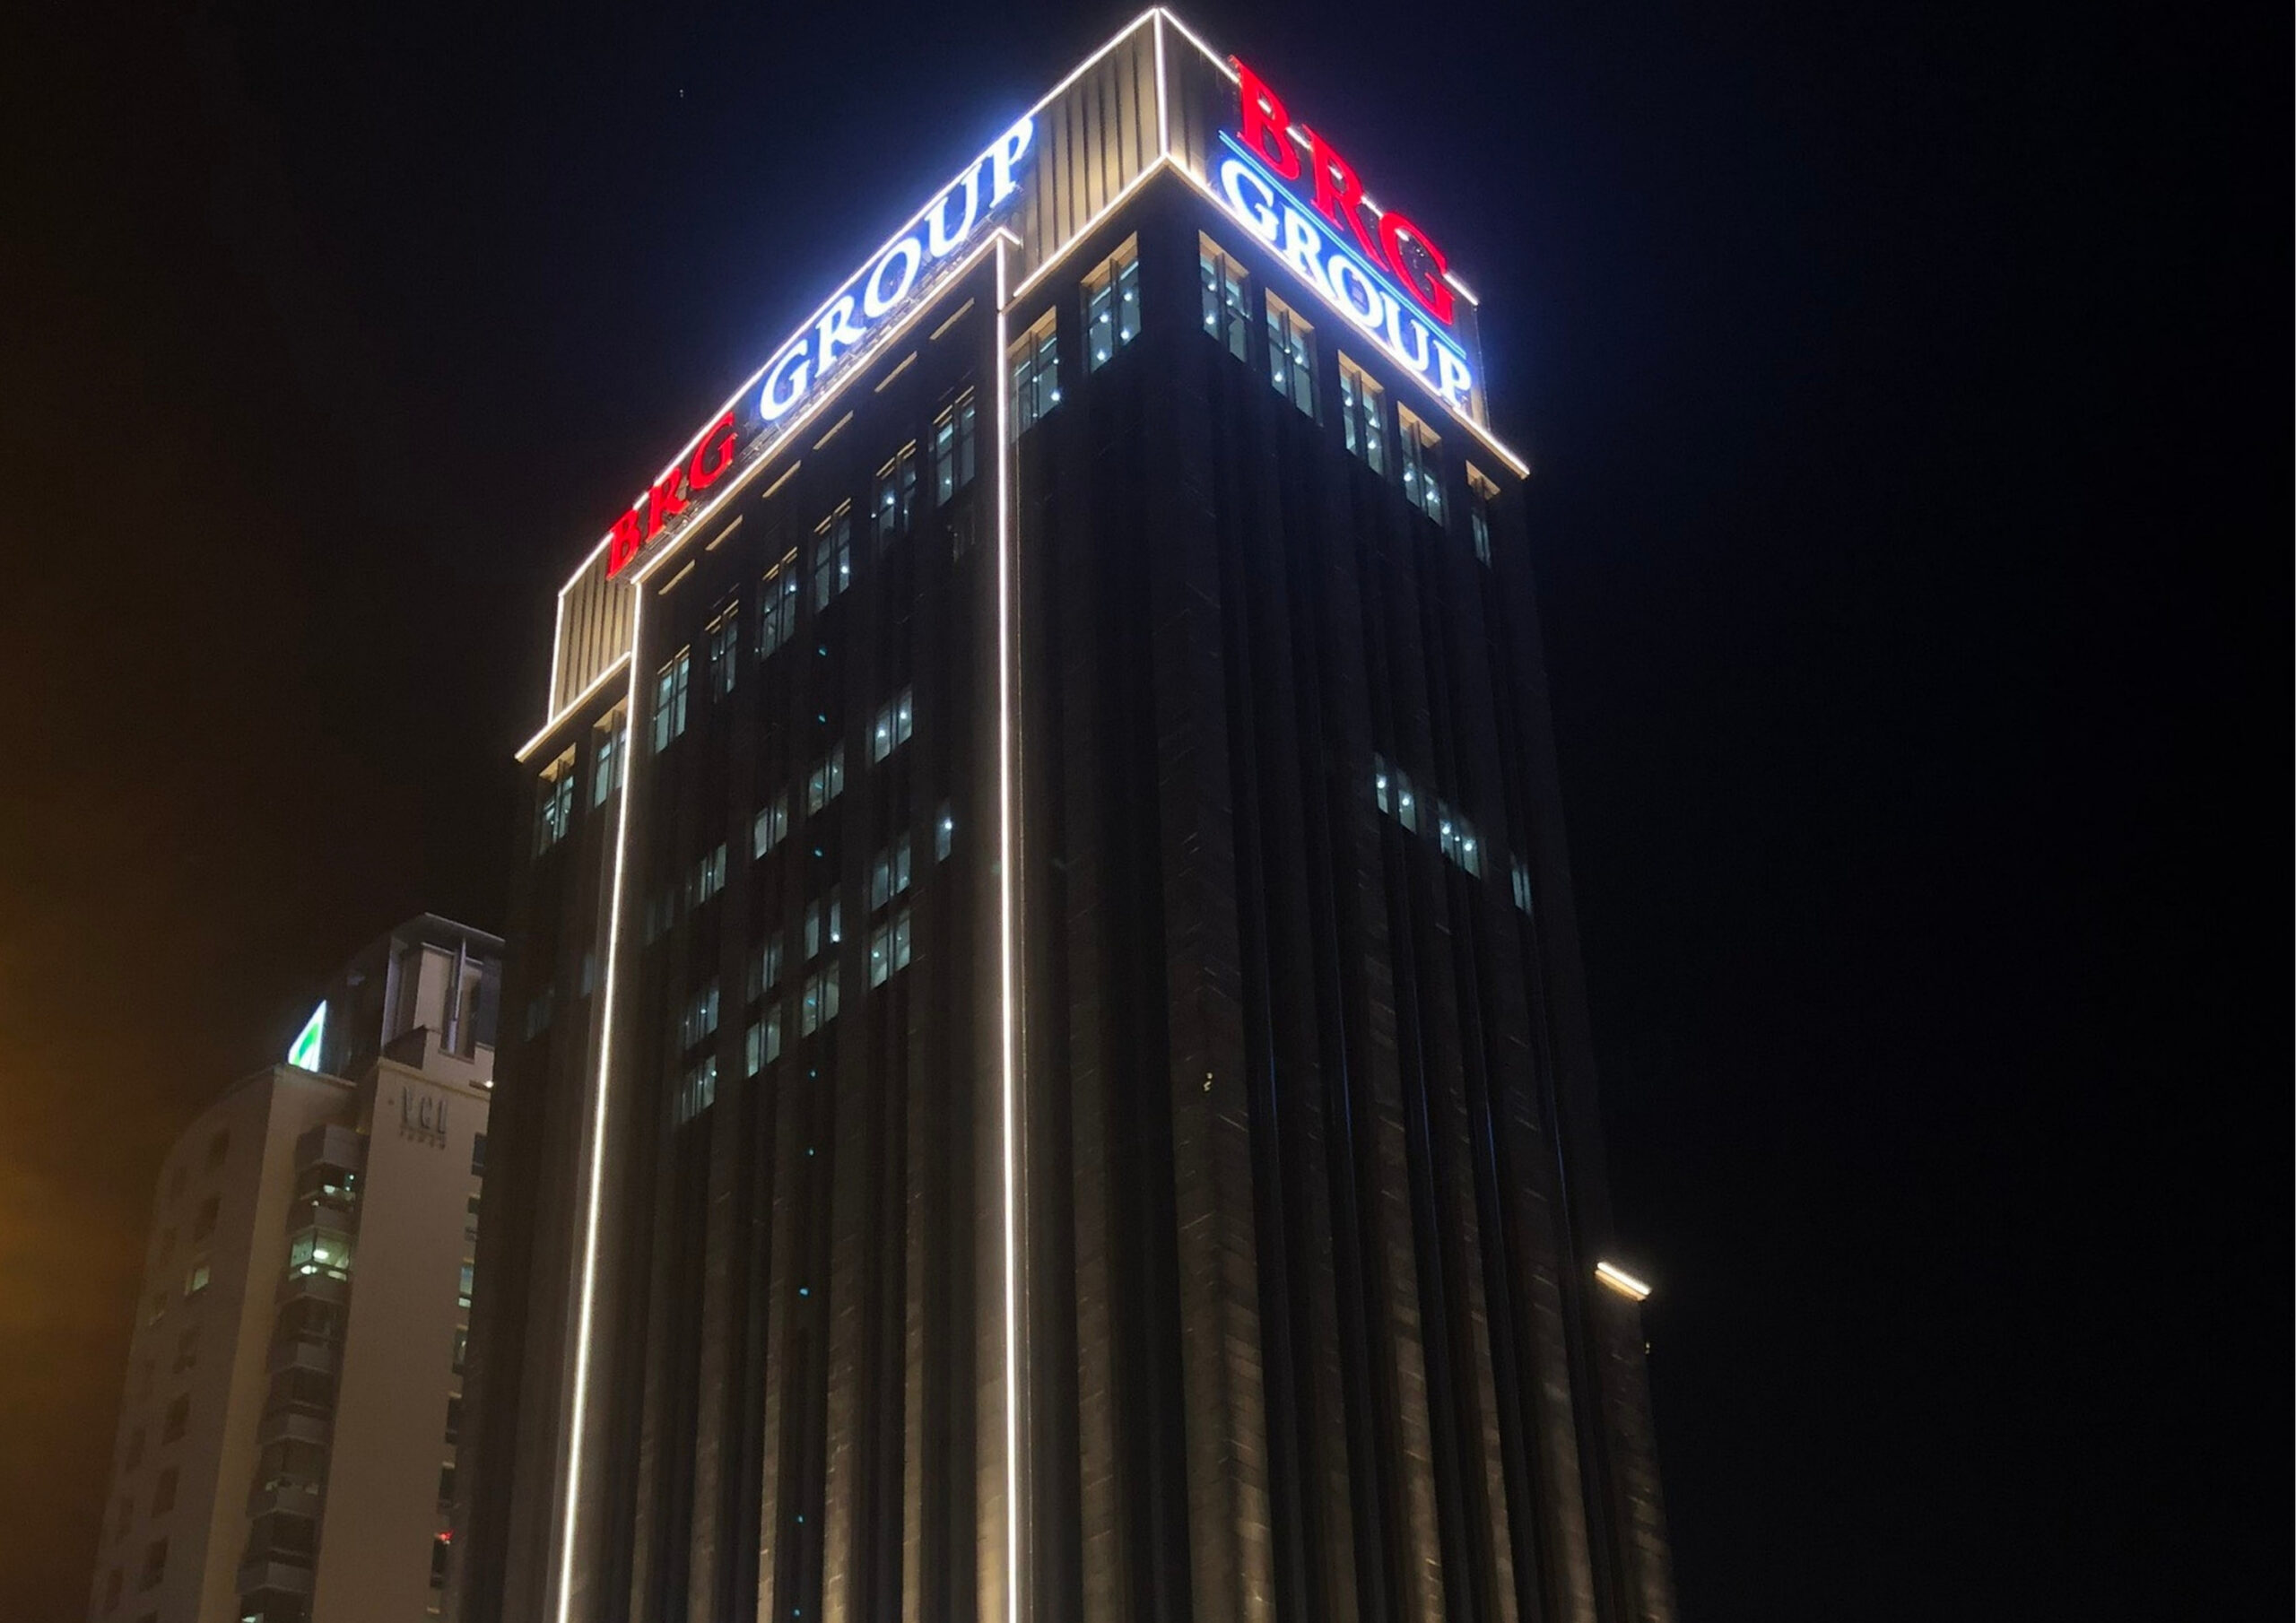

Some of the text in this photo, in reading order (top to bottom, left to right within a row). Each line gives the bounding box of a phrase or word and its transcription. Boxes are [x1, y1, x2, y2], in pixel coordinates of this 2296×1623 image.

[1221, 159, 1472, 408] GROUP
[1228, 55, 1455, 325] BRG
[606, 116, 1034, 580] BRG GROUP
